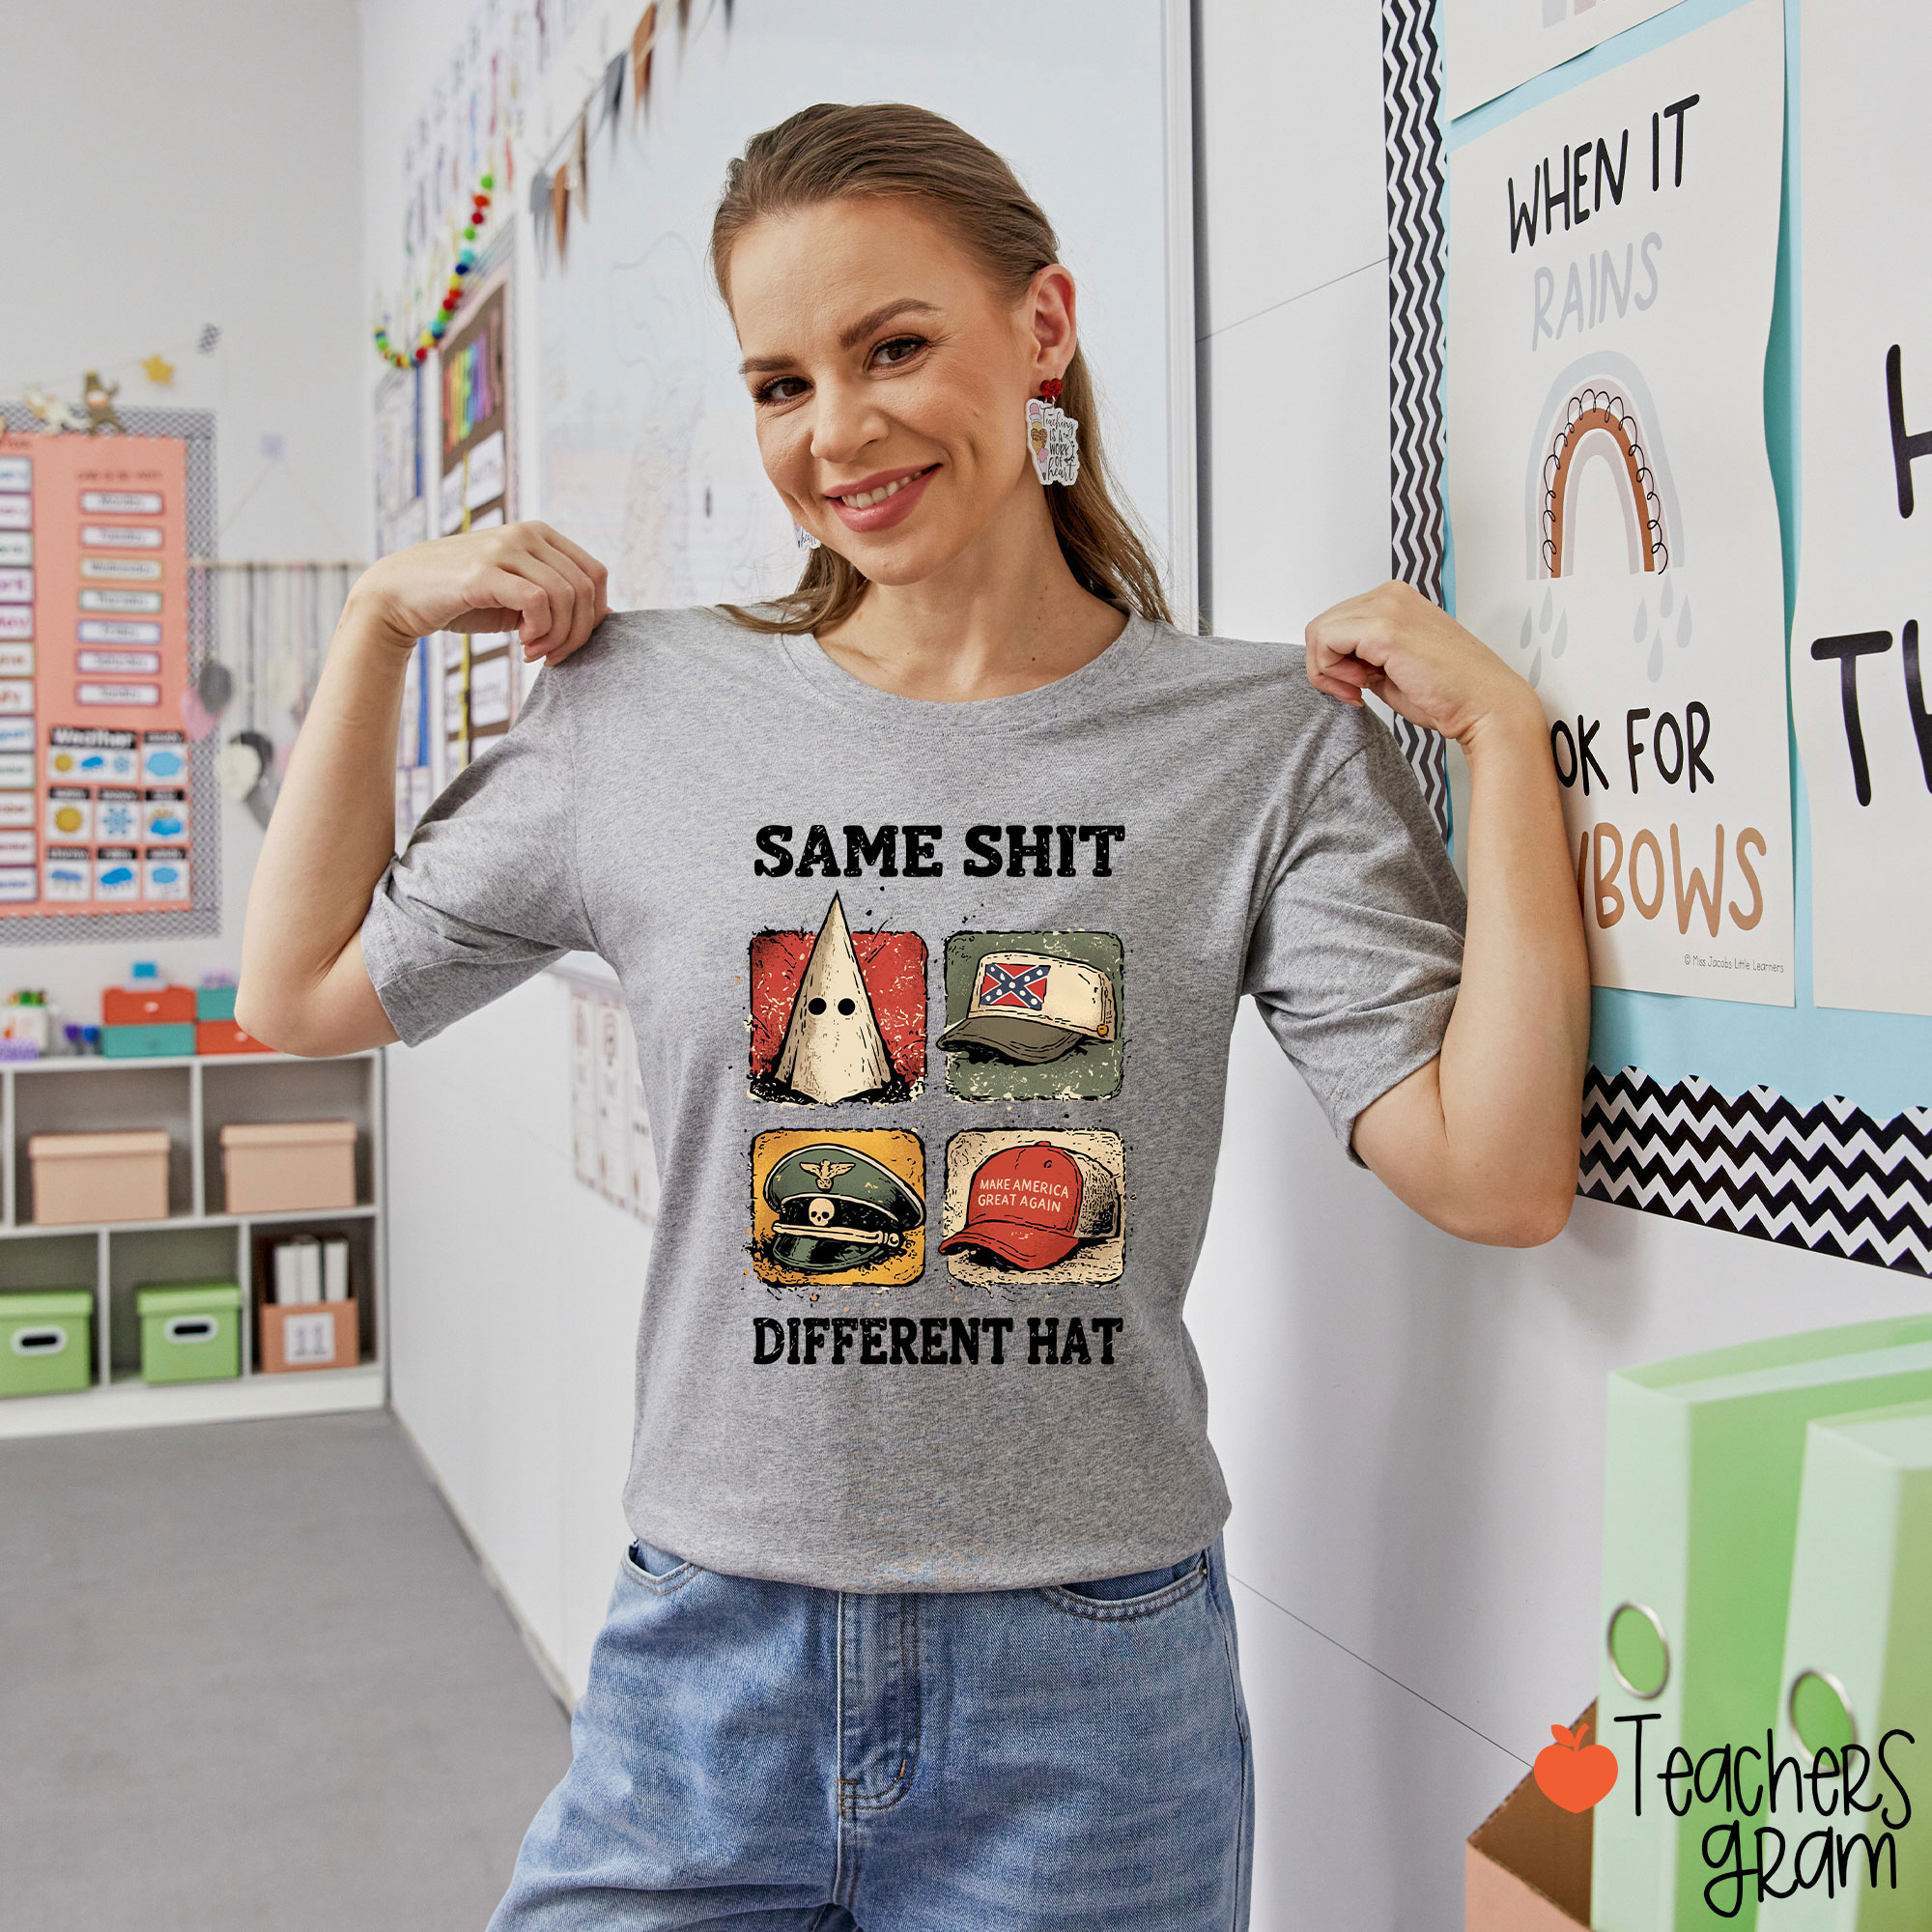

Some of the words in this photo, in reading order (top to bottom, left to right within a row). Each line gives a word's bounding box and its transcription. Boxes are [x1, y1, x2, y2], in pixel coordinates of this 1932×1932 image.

[1508, 129, 1629, 253] WHEN
[1653, 94, 1700, 191] IT
[1532, 232, 1662, 352] RAINS
[1039, 404, 1076, 440] Teaching
[1049, 428, 1056, 442] IS
[1059, 429, 1064, 442] A
[1049, 442, 1069, 456] WORK
[1055, 456, 1063, 468] OF
[1047, 456, 1077, 481] heart
[1550, 714, 1609, 796] OK
[1627, 701, 1715, 794] FOR
[753, 825, 943, 878] SAME
[963, 825, 1125, 878] SHIT
[1577, 822, 1767, 938] BOWS
[1692, 954, 1707, 967] Miss
[1708, 954, 1732, 970] Jacobs
[1734, 957, 1750, 971] Little
[1752, 958, 1784, 974] Learners
[978, 1193, 1017, 1208] GREAT
[1019, 1194, 1062, 1213] AGAIN
[980, 1178, 1011, 1191] MAKE
[1012, 1178, 1069, 1199] AMERICA
[753, 1317, 1013, 1366] DIFFERENT
[1027, 1317, 1123, 1366] HAT
